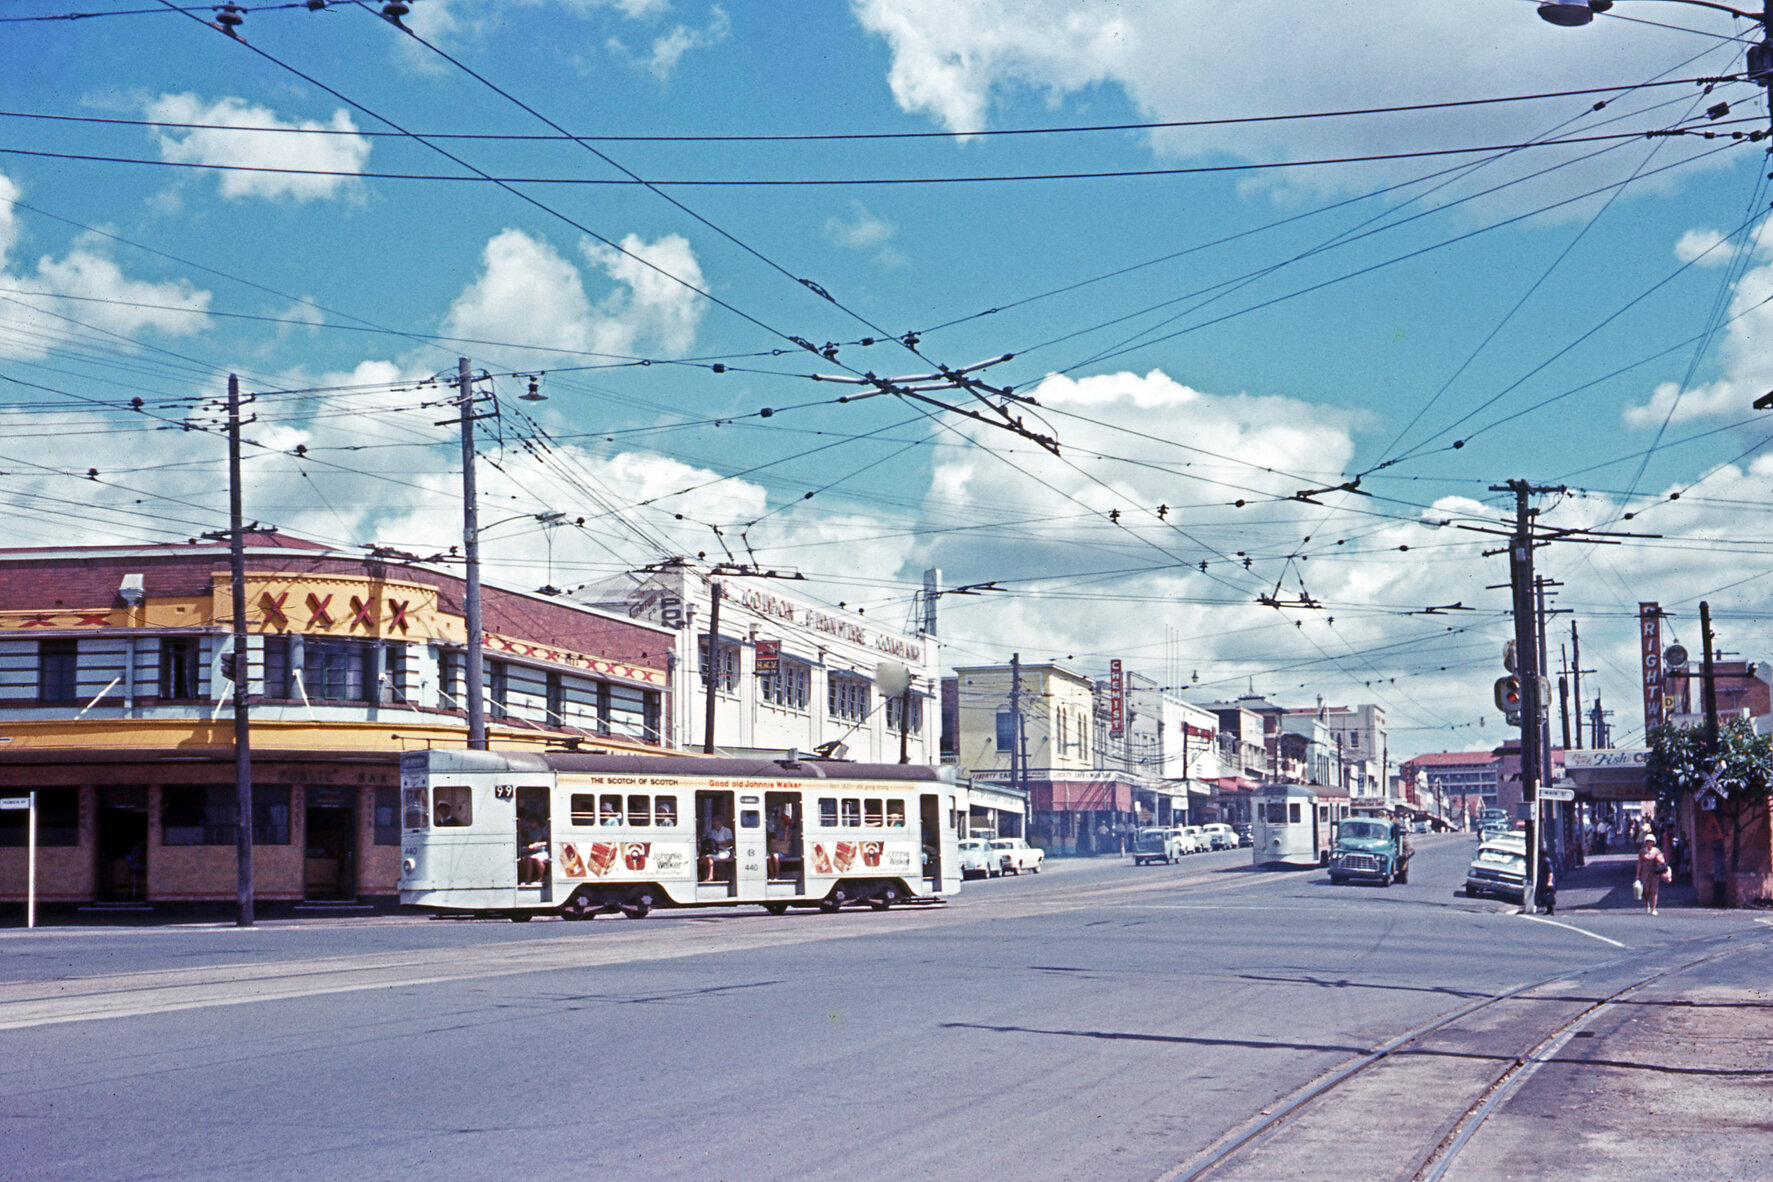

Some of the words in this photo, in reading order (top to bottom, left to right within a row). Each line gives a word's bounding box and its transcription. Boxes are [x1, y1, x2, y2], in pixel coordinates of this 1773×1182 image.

[262, 591, 410, 631] XXXX
[742, 588, 794, 621] COUPON
[585, 659, 653, 682] XXXX
[1111, 661, 1121, 729] CHEMIST
[1594, 751, 1626, 766] Fish
[709, 779, 729, 787] Good
[732, 780, 743, 788] old
[744, 780, 775, 788] Johnnie
[776, 781, 802, 789] Walker
[496, 785, 512, 797] 99
[404, 847, 417, 855] 440
[652, 851, 682, 860] Johnnie
[656, 859, 682, 869] Walker
